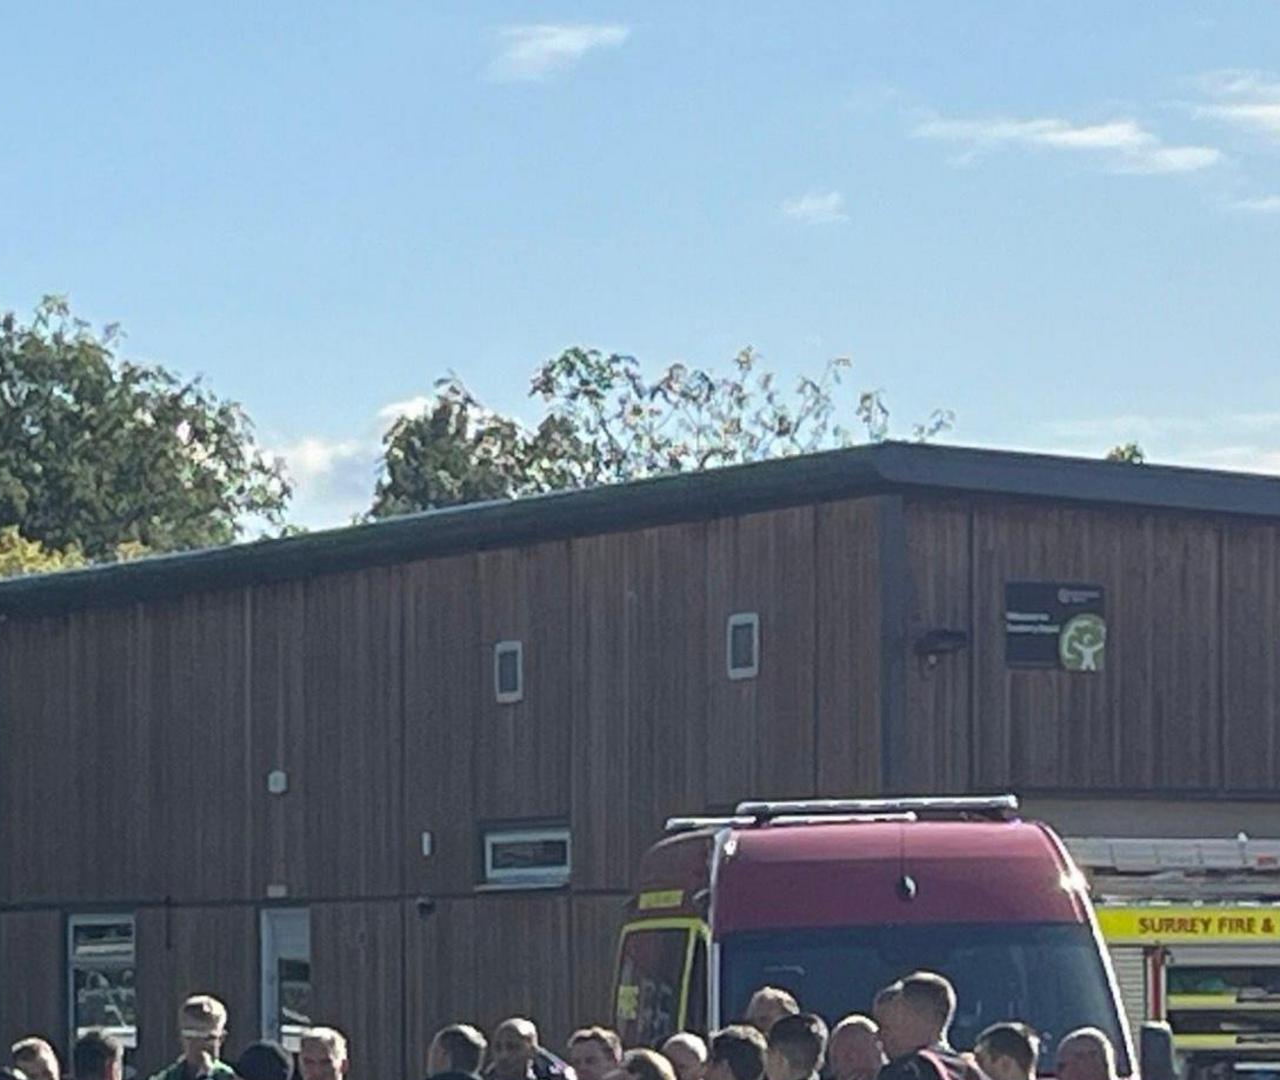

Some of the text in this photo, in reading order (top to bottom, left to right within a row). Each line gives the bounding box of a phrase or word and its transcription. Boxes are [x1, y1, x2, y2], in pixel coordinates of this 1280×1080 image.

[1138, 917, 1211, 934] SURREY
[1218, 917, 1256, 933] FIRE
[1261, 917, 1274, 933] &
